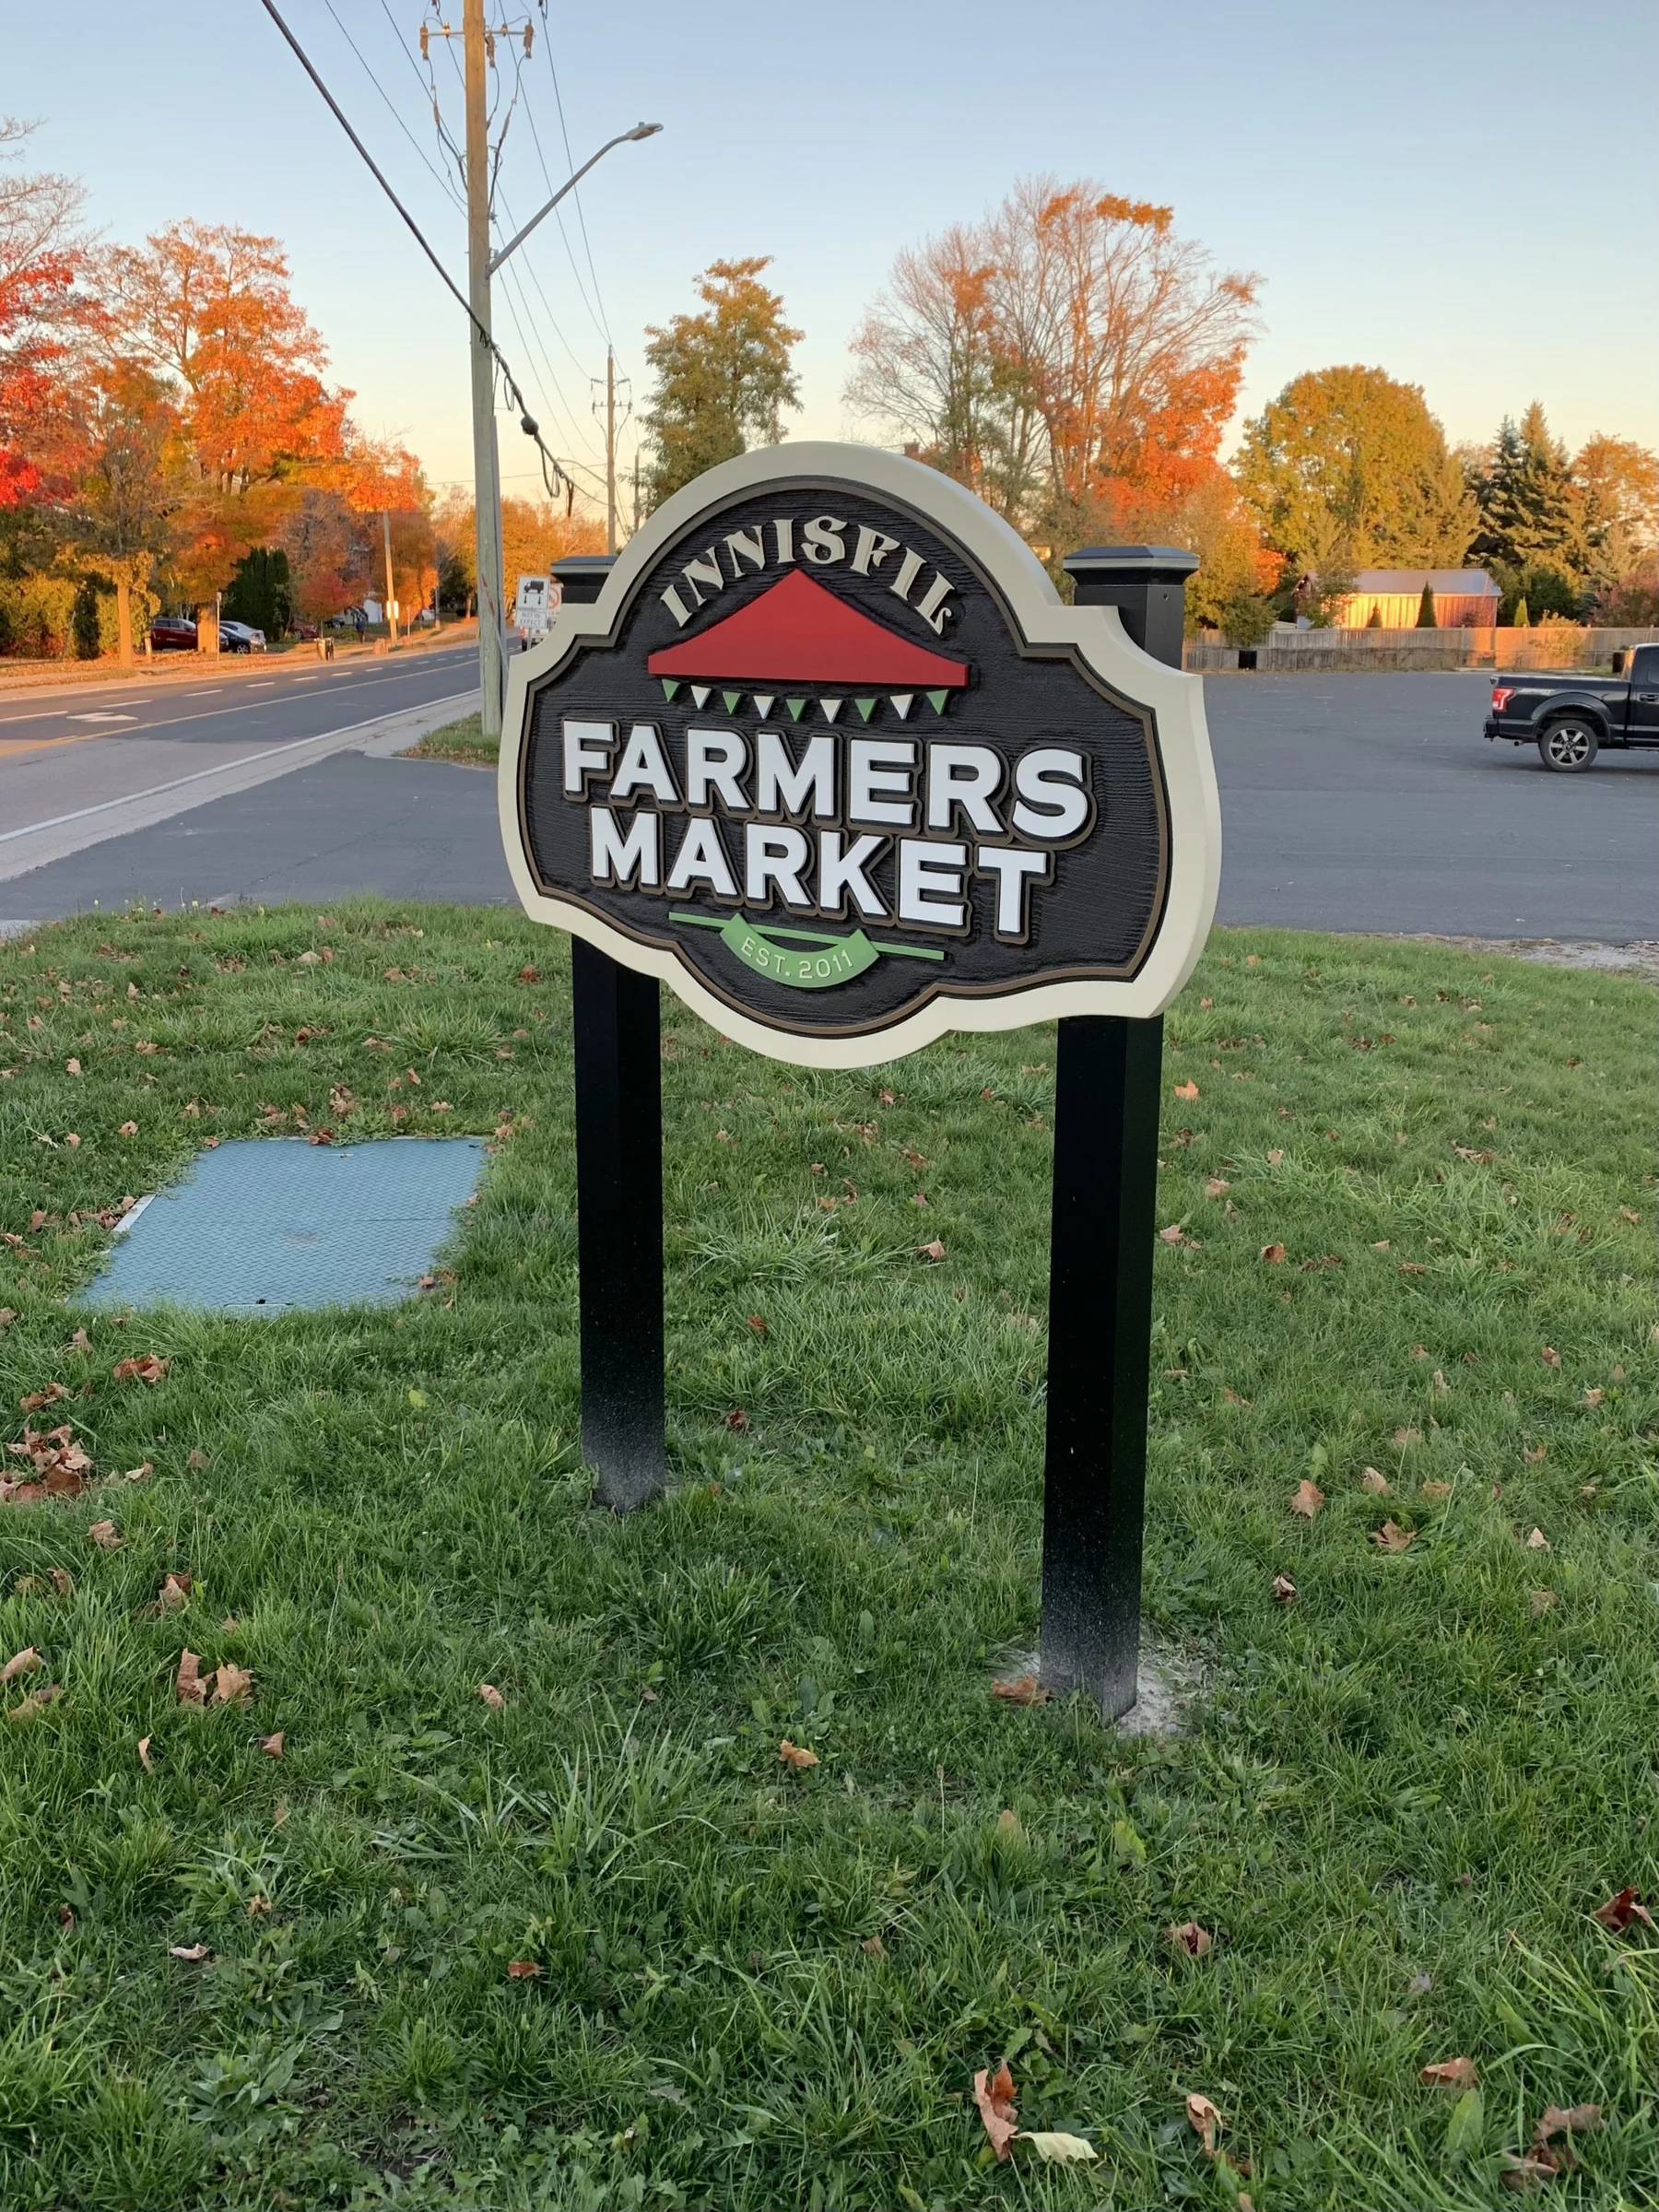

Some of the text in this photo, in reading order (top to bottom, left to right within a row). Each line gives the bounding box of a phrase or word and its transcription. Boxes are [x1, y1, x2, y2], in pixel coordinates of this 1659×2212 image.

[660, 515, 956, 635] INNISFIL
[562, 719, 1091, 839] FARMERS
[590, 806, 1047, 934] MARKET
[740, 935, 853, 979] EST. 2011
